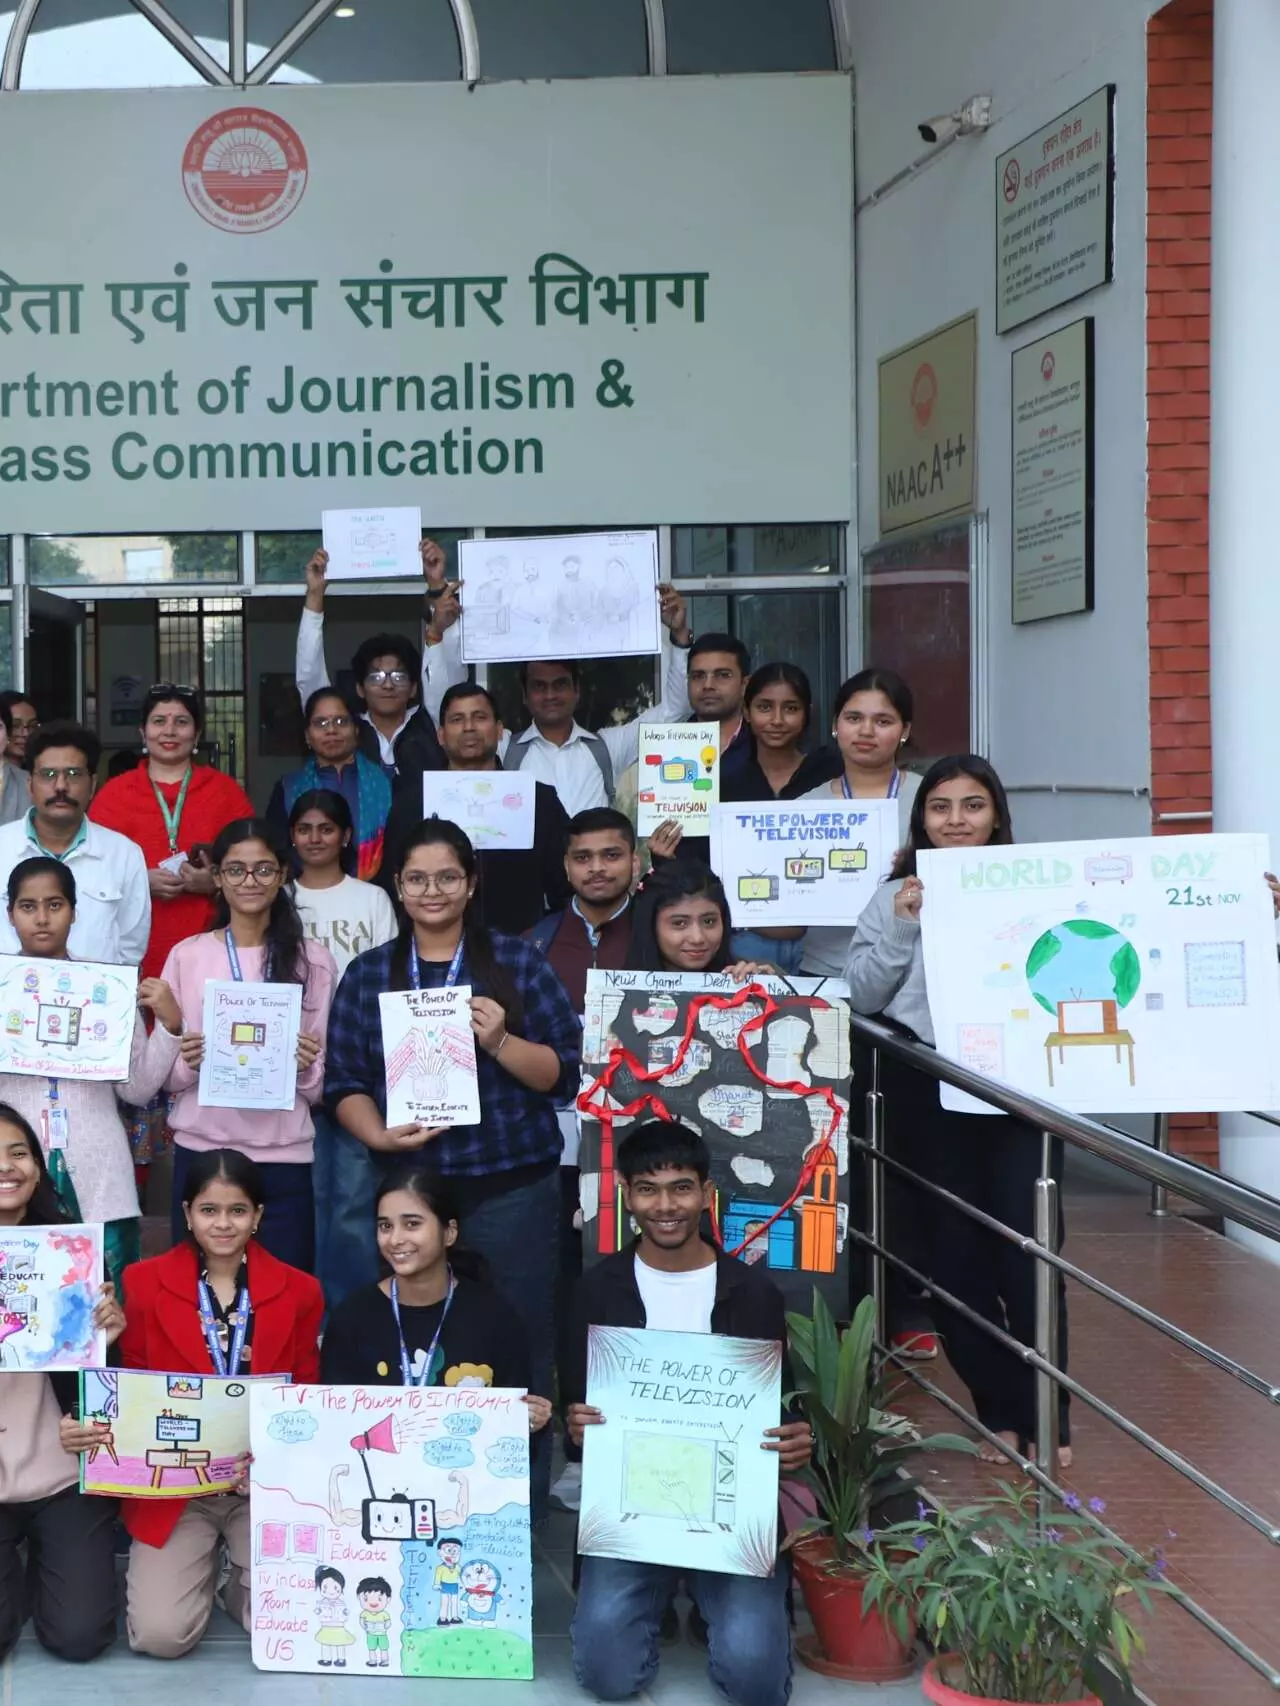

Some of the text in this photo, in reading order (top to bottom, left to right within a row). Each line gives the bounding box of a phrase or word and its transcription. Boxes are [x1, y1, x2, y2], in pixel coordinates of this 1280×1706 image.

[105, 262, 190, 343] एवं
[212, 280, 318, 332] जन
[340, 258, 508, 329] संचार
[529, 253, 710, 326] विभाग
[198, 366, 251, 415] of
[267, 361, 575, 413] Journalism
[596, 359, 635, 409] &
[112, 426, 545, 482] Communication
[886, 460, 928, 509] NAAC
[930, 433, 967, 494] A++
[735, 813, 868, 828] THE POWER OF
[754, 827, 850, 841] TELEVISION
[960, 857, 1073, 889] WORLD
[1151, 851, 1216, 879] DAY
[1166, 886, 1241, 907] 21st NOV
[421, 992, 445, 1004] POWER
[446, 991, 459, 1003] OF
[619, 1355, 746, 1387] THE POWER OF
[629, 1380, 756, 1411] TELEVISION
[328, 1529, 342, 1541] To
[330, 1543, 387, 1562] Educate
[276, 1572, 289, 1586] in
[255, 1615, 309, 1633] Educate
